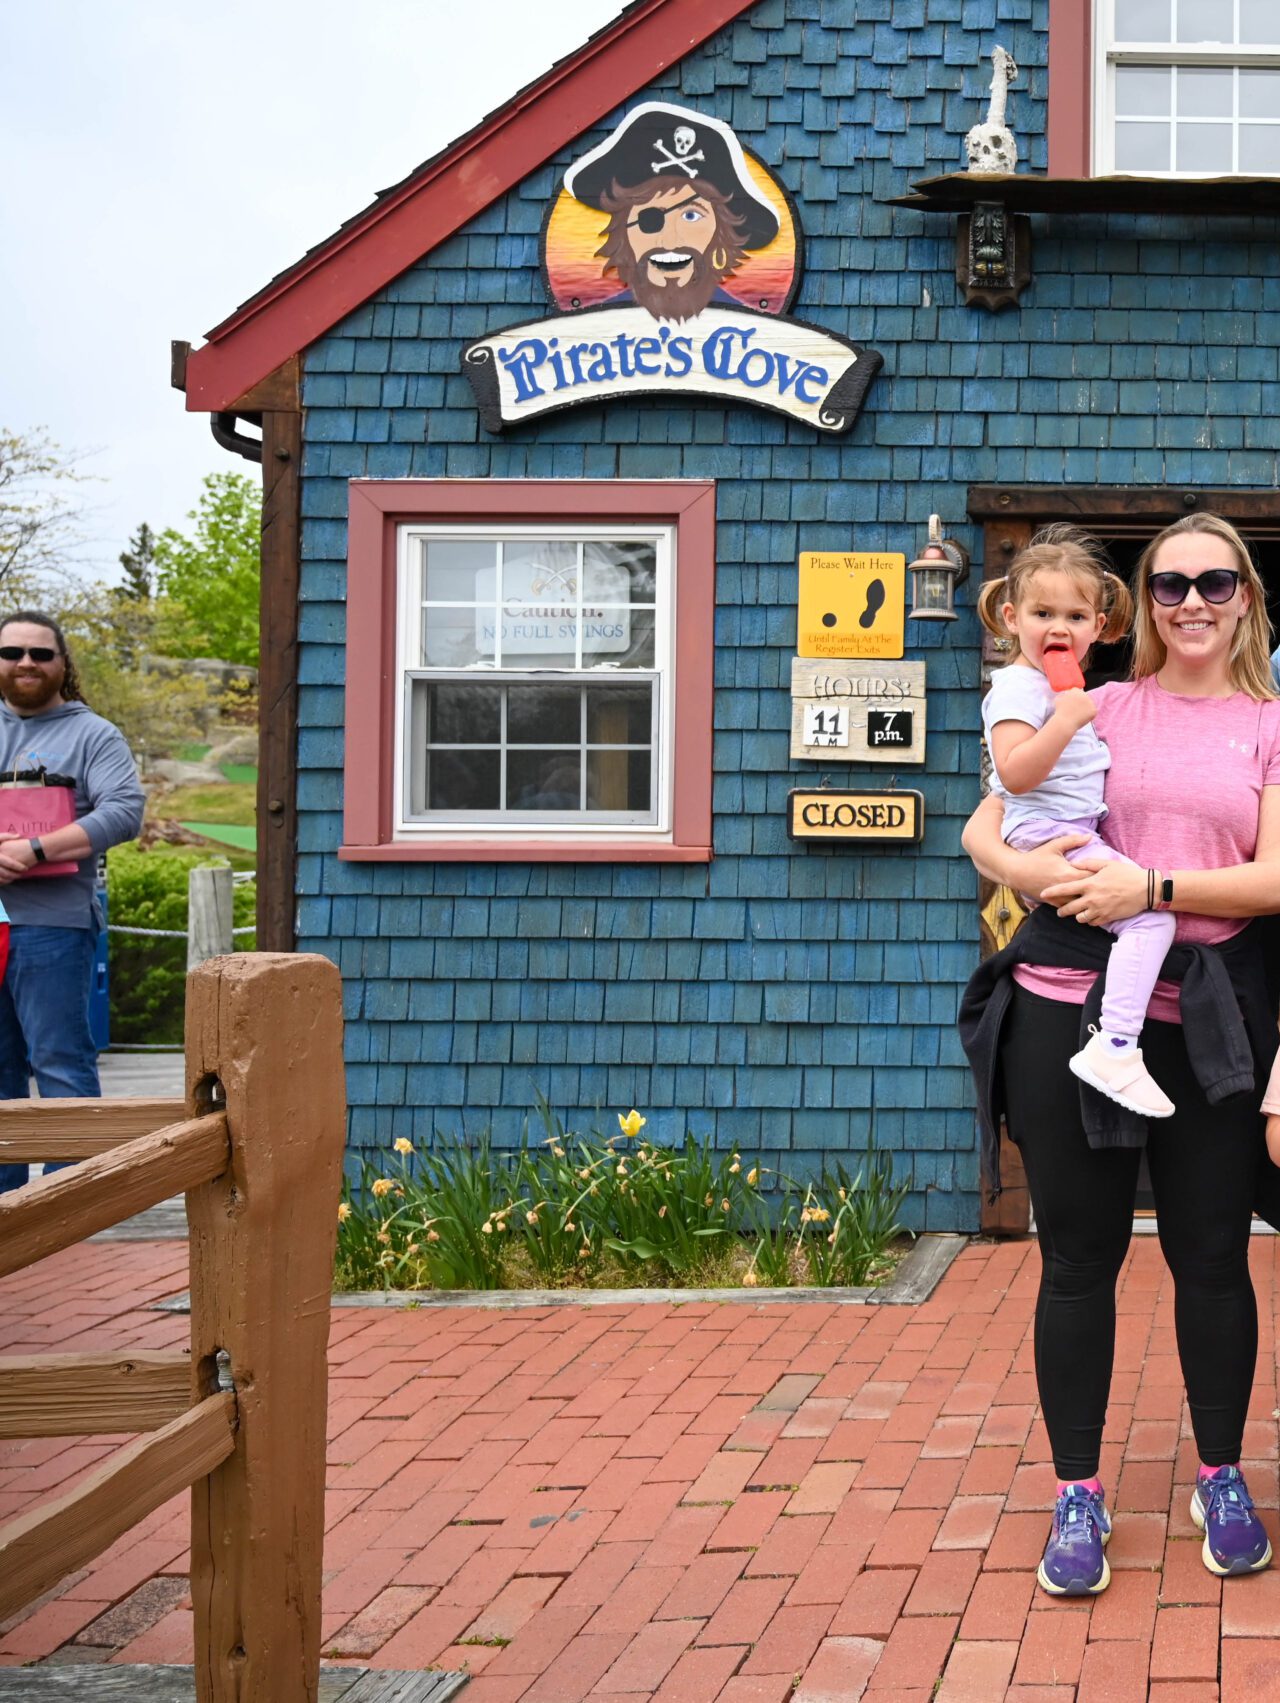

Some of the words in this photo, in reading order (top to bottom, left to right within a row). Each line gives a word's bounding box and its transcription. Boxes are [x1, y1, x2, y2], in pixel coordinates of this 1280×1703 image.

[499, 326, 693, 404] Pirate's
[702, 326, 829, 404] Cove
[810, 557, 840, 569] Please
[843, 557, 865, 569] Wait
[869, 558, 894, 570] Here
[513, 625, 553, 639] FULL
[808, 633, 830, 643] Until
[875, 633, 892, 644] The
[815, 644, 854, 656] Register
[812, 710, 842, 735] 11
[884, 712, 898, 731] 7
[874, 730, 904, 744] p.m.
[802, 802, 906, 828] CLOSED
